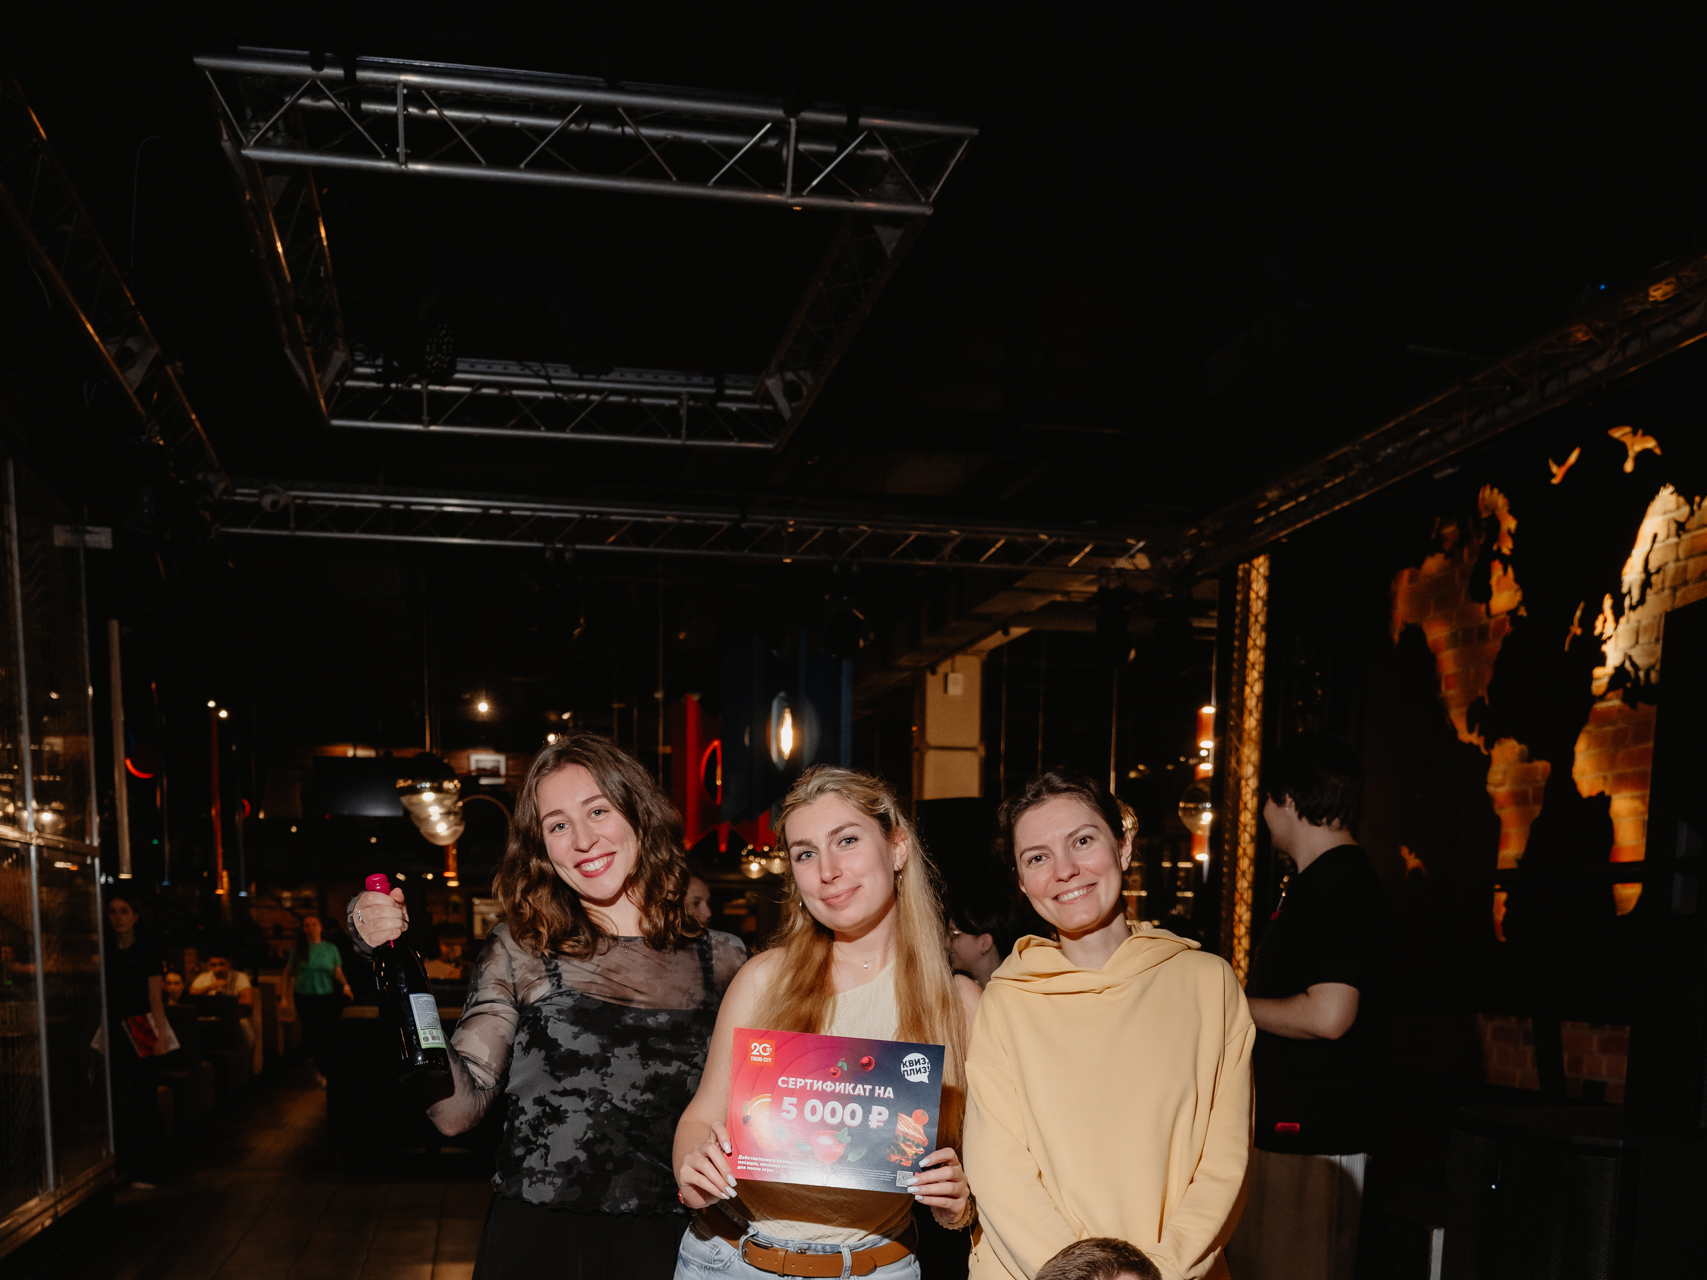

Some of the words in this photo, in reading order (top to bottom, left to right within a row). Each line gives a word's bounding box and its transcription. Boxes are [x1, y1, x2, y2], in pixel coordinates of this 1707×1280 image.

[777, 1076, 873, 1097] СЕРТИФИКАТ
[874, 1085, 895, 1099] НА
[780, 1096, 798, 1120] 5
[803, 1098, 863, 1128] 000
